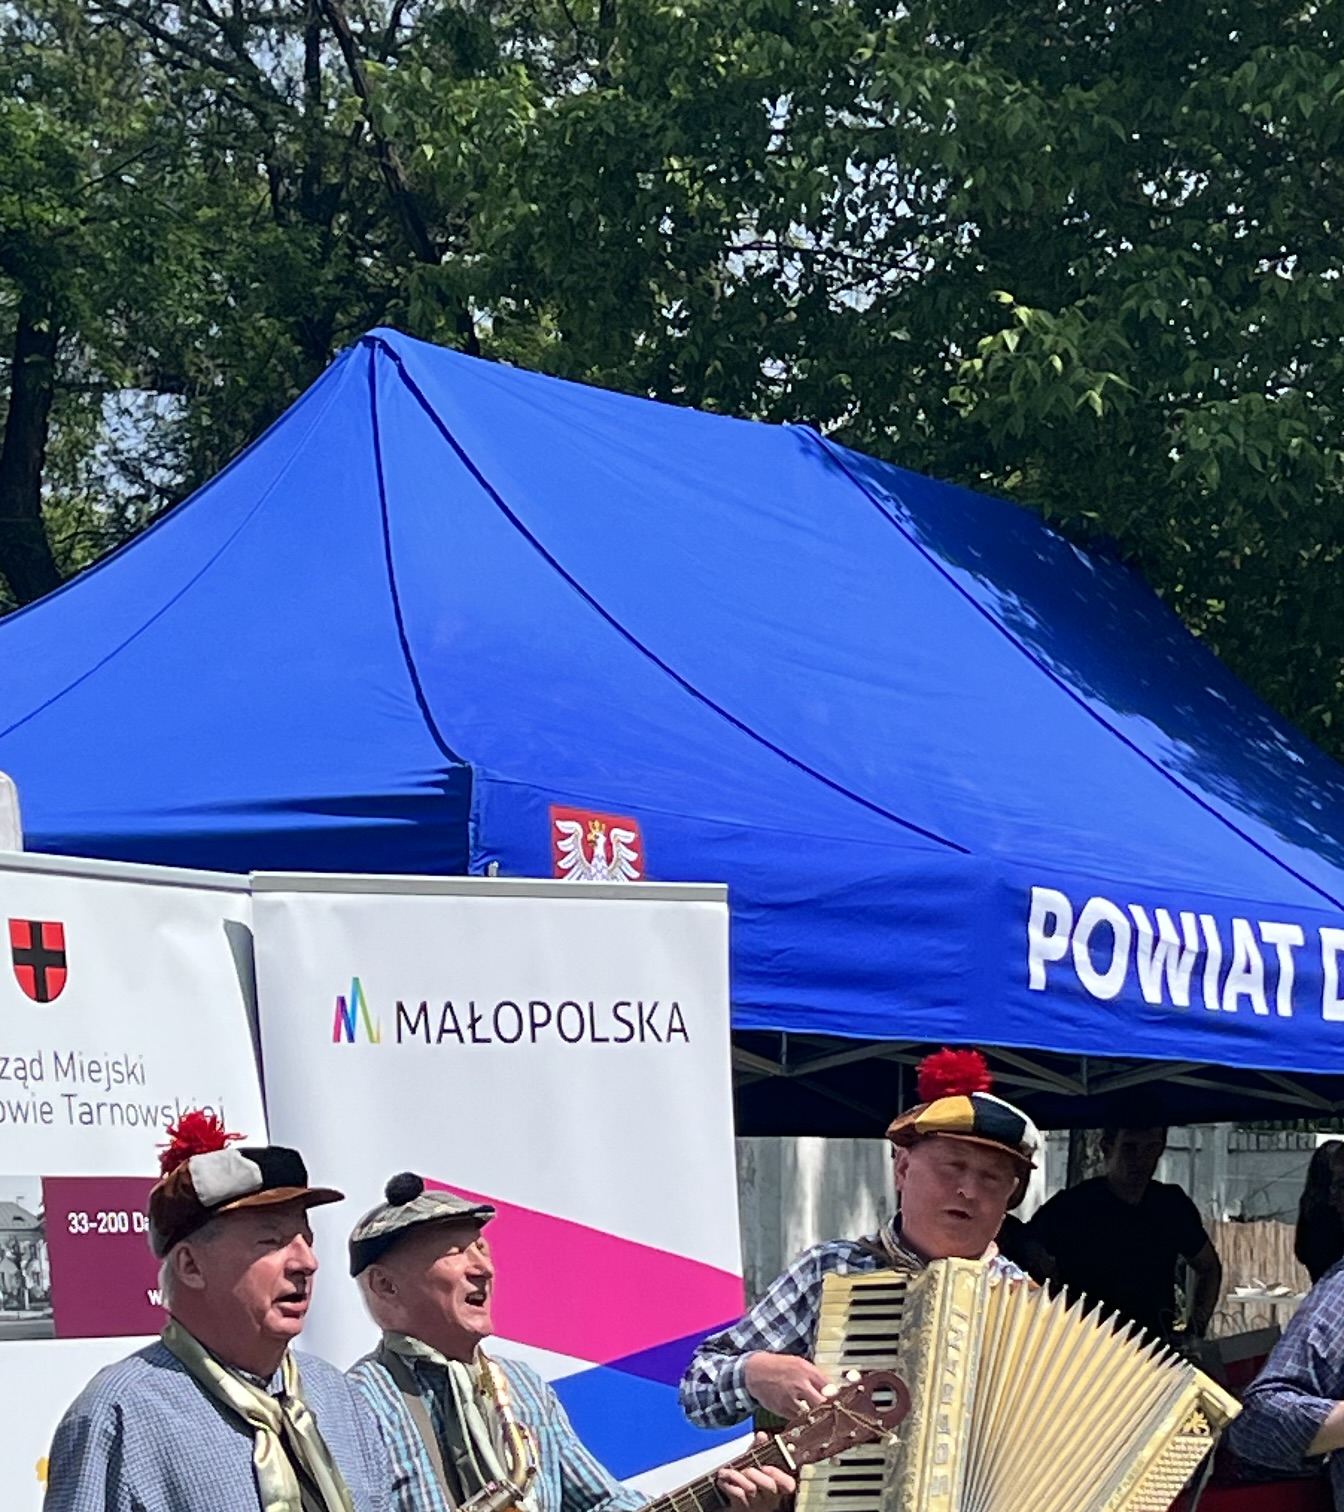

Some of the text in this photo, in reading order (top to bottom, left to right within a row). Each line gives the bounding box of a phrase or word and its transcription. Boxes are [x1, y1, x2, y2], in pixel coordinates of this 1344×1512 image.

[1027, 886, 1305, 1017] POWIAT
[395, 999, 691, 1045] MAŁOPOLSKA
[53, 1050, 147, 1092] Miejski
[67, 1211, 130, 1234] 33-200
